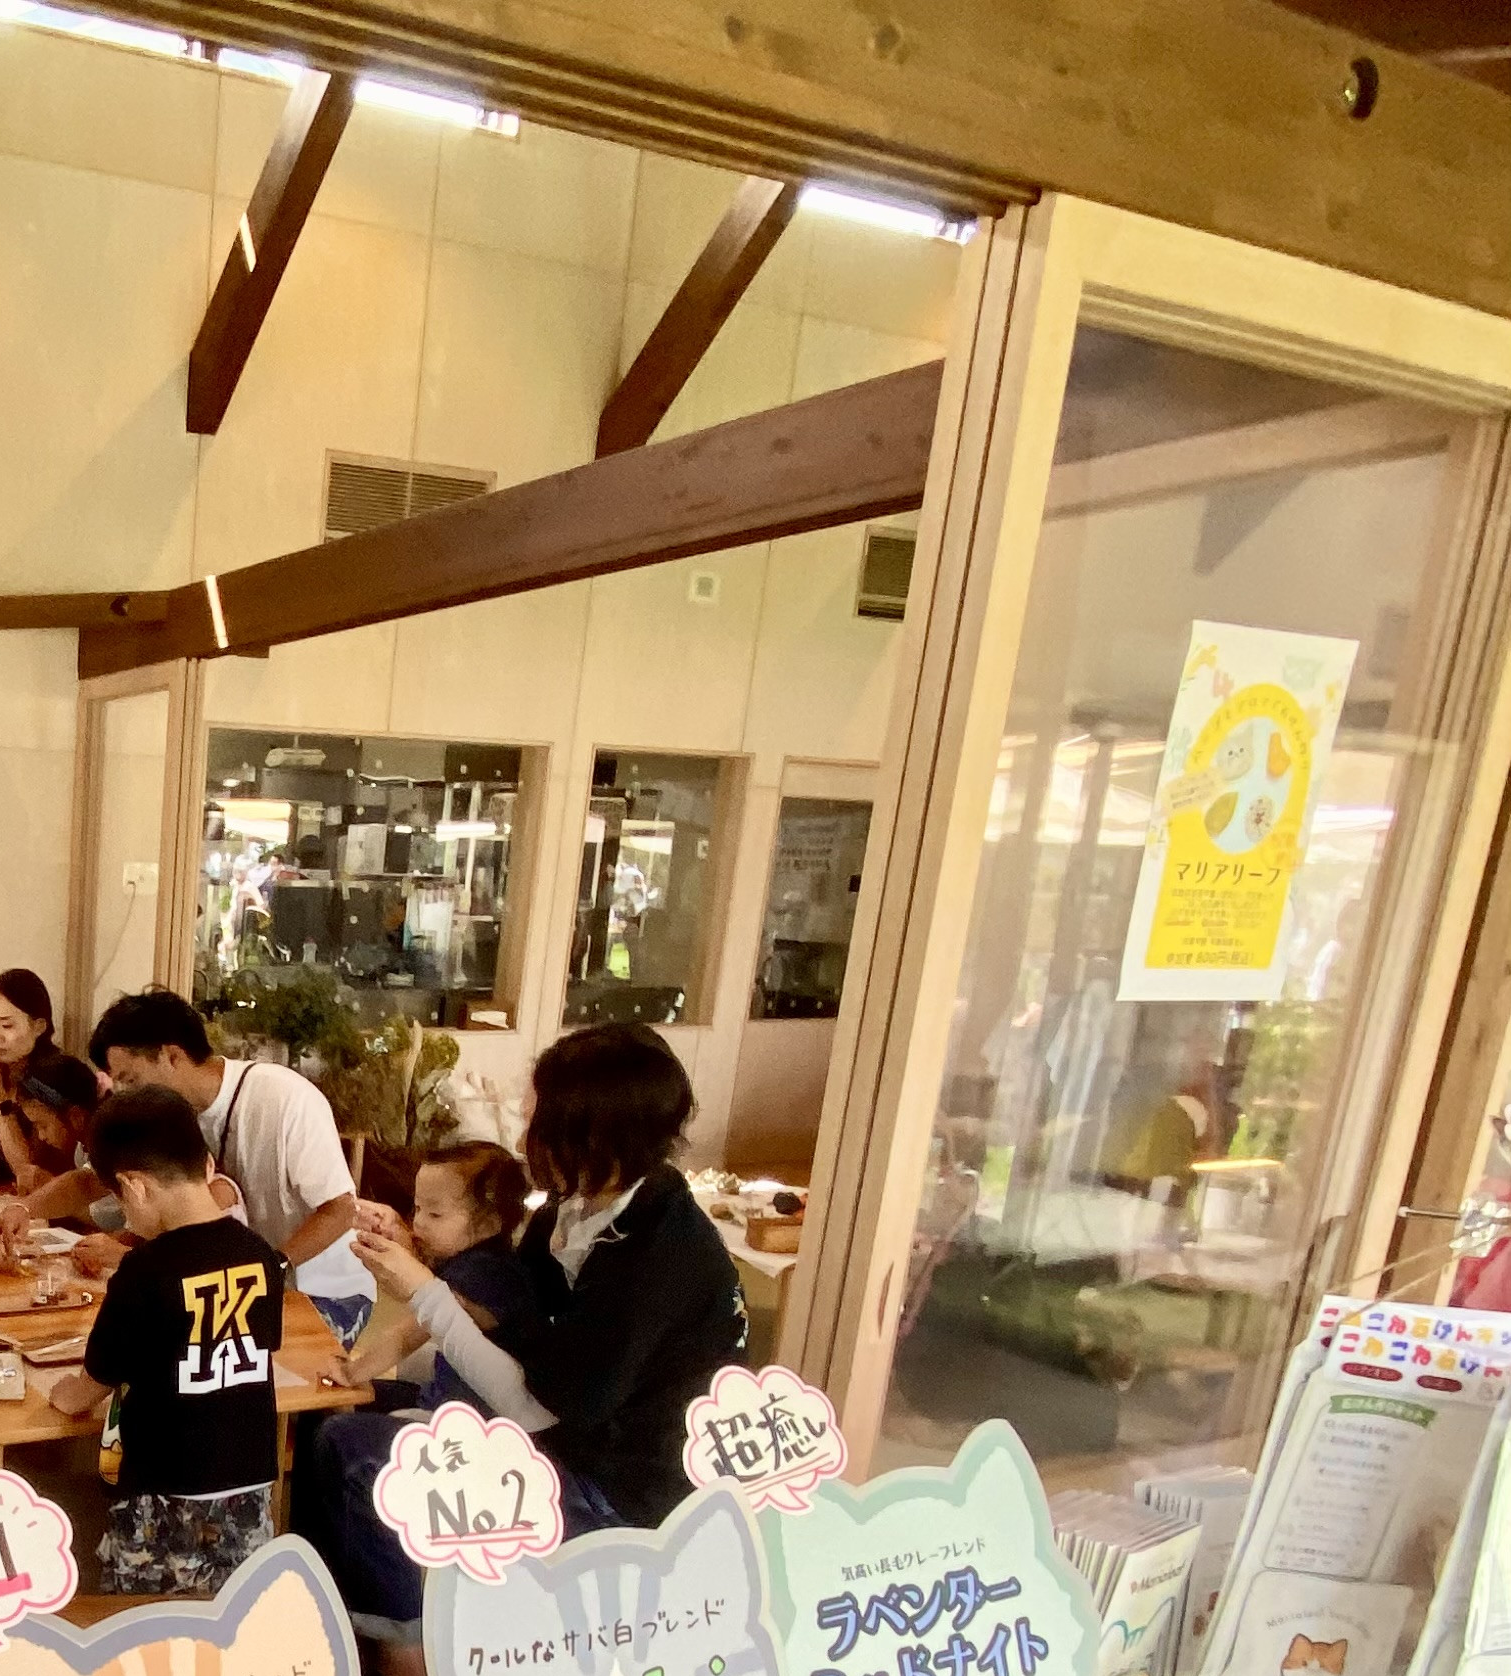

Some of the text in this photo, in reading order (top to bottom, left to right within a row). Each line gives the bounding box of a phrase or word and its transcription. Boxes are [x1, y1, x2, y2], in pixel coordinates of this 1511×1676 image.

[1176, 862, 1281, 885] マリアリーフ
[413, 1437, 470, 1475] 人気
[701, 1393, 827, 1483] 超癒し
[817, 1565, 1021, 1662] ラベンダー
